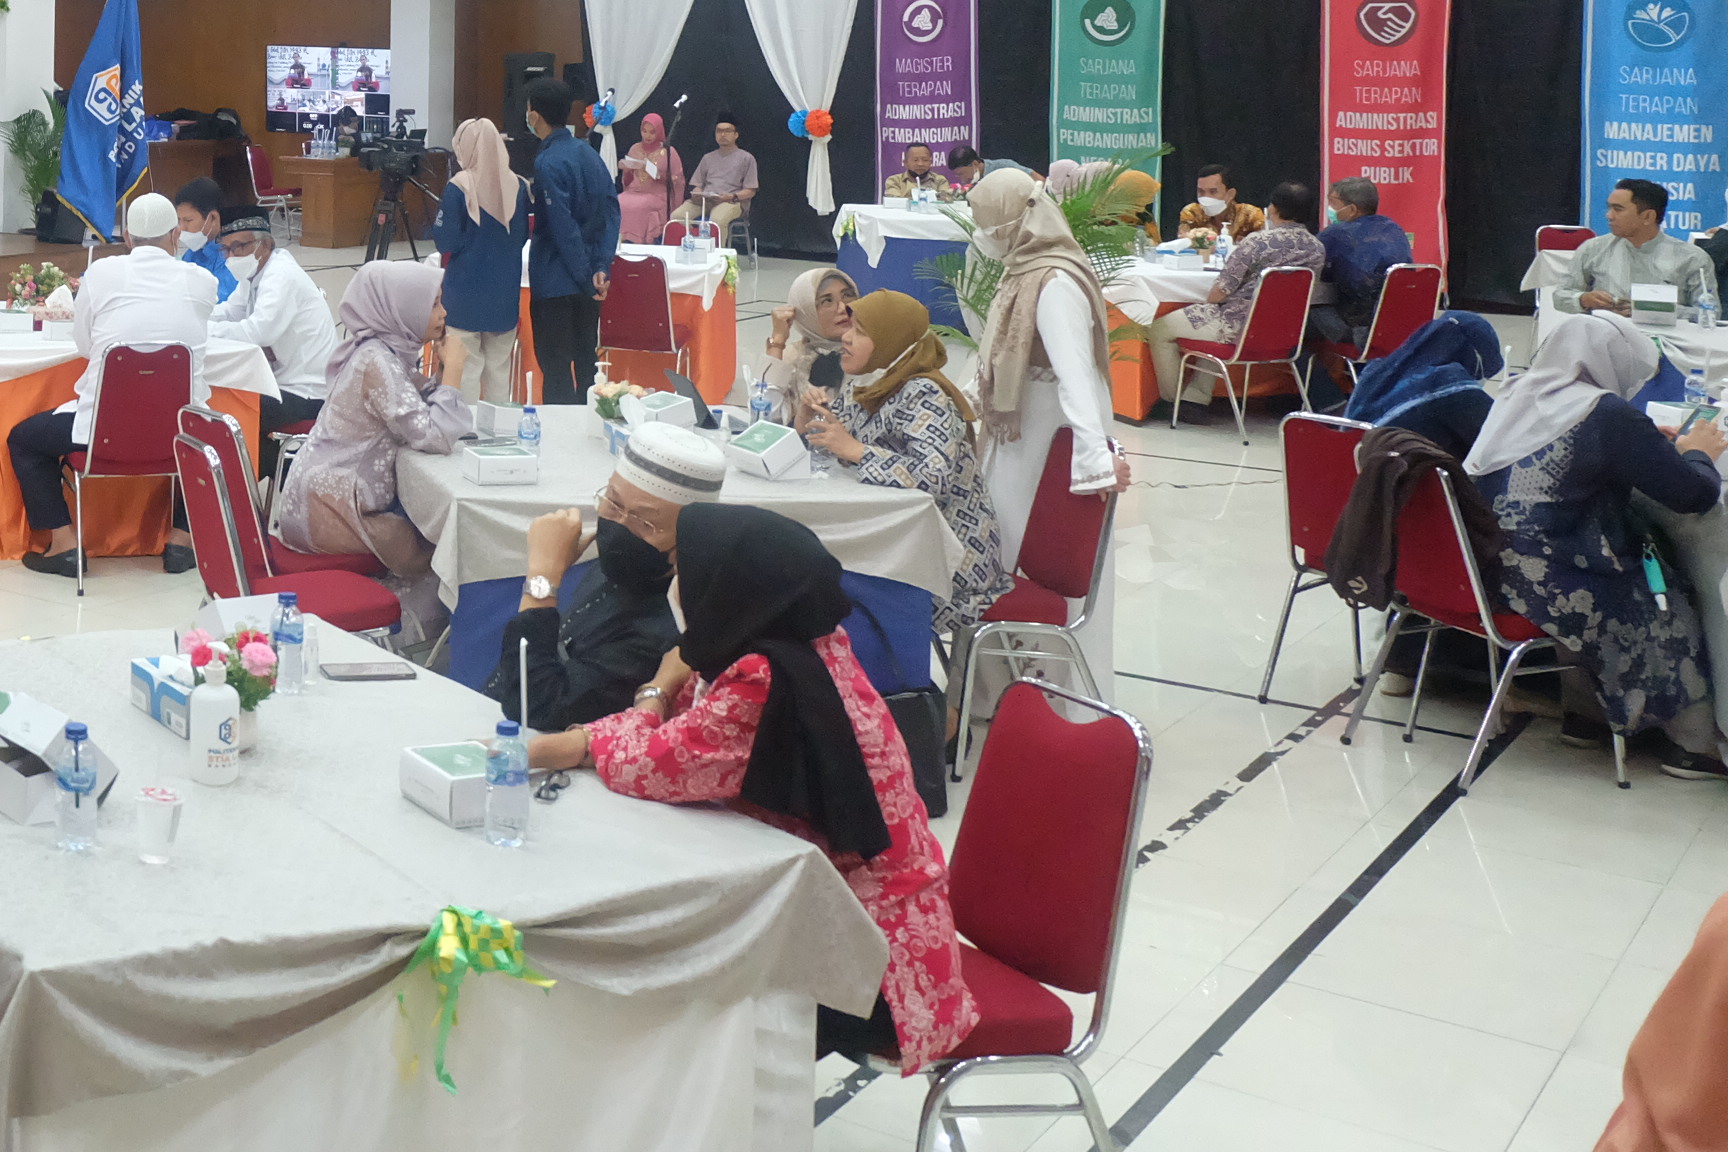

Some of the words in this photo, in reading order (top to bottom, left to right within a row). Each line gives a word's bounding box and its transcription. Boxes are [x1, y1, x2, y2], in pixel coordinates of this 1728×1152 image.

[895, 56, 952, 74] MAGISTER
[1079, 57, 1136, 75] SARJANA
[1353, 59, 1421, 78] SARJANA
[1619, 65, 1697, 86] SARJANA
[897, 80, 952, 97] TERAPAN
[1079, 81, 1136, 100] TERAPAN
[1353, 86, 1422, 104] TERAPAN
[885, 101, 965, 119] ADMINISTRASI
[1619, 93, 1698, 115] TERAPAN
[1063, 105, 1152, 124] ADMINISTRASI
[1336, 111, 1437, 130] ADMINISTRASI
[882, 125, 969, 143] PEMBANGUNAN
[1059, 128, 1155, 148] PEMBANGUNAN
[1604, 121, 1712, 143] MANAJEMEN
[1333, 137, 1381, 157] BISNIS
[1384, 138, 1438, 158] SEKTOR
[1672, 152, 1721, 172] DAYA
[1361, 166, 1414, 185] PUBLIK
